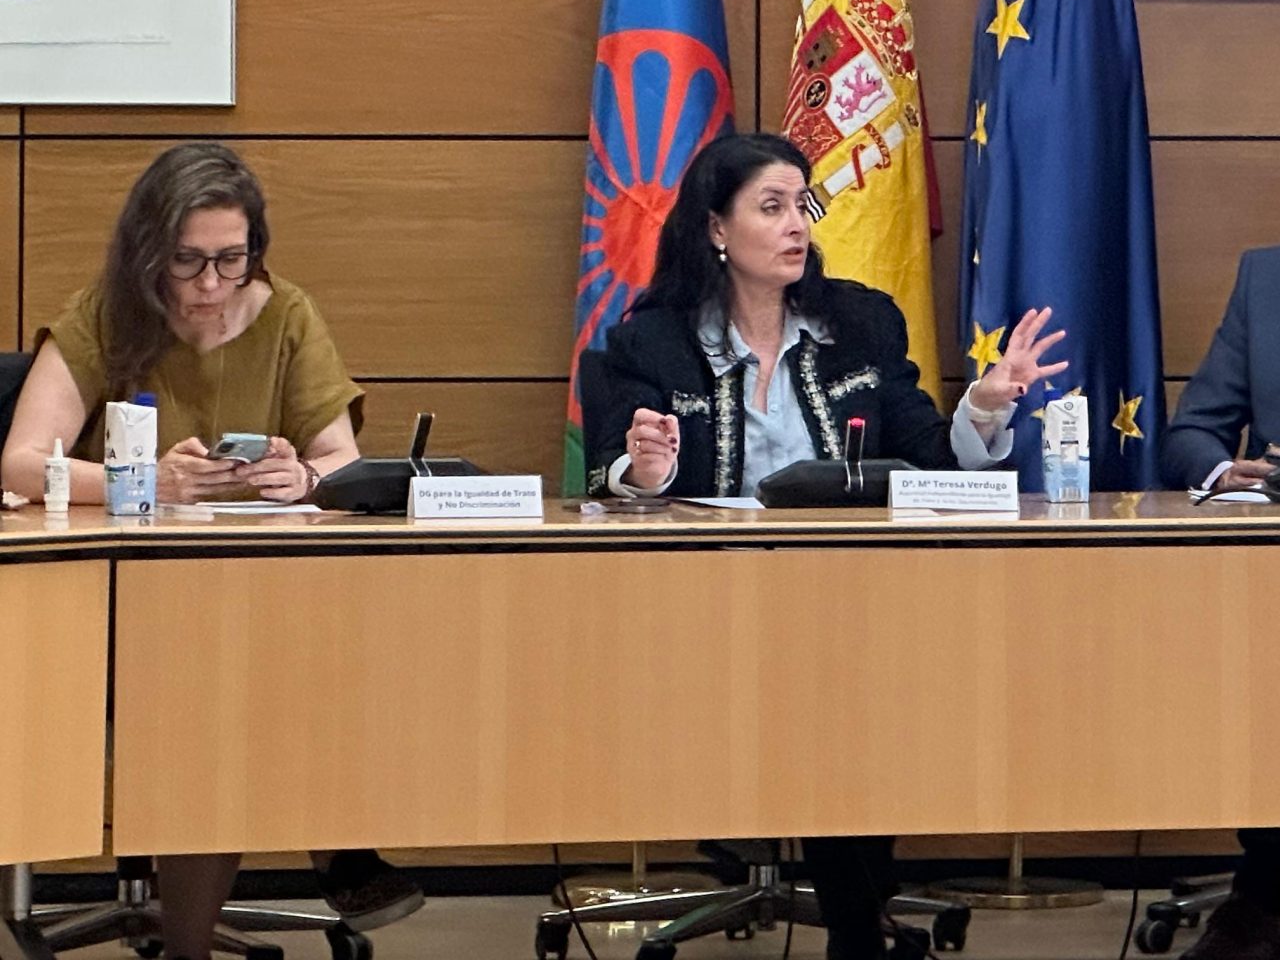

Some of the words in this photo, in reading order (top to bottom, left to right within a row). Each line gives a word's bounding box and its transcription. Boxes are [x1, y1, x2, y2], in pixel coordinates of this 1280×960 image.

[933, 480, 965, 489] Teresa
[967, 481, 1008, 492] Verdugo
[433, 491, 453, 499] para
[501, 490, 512, 498] de
[445, 501, 457, 509] No
